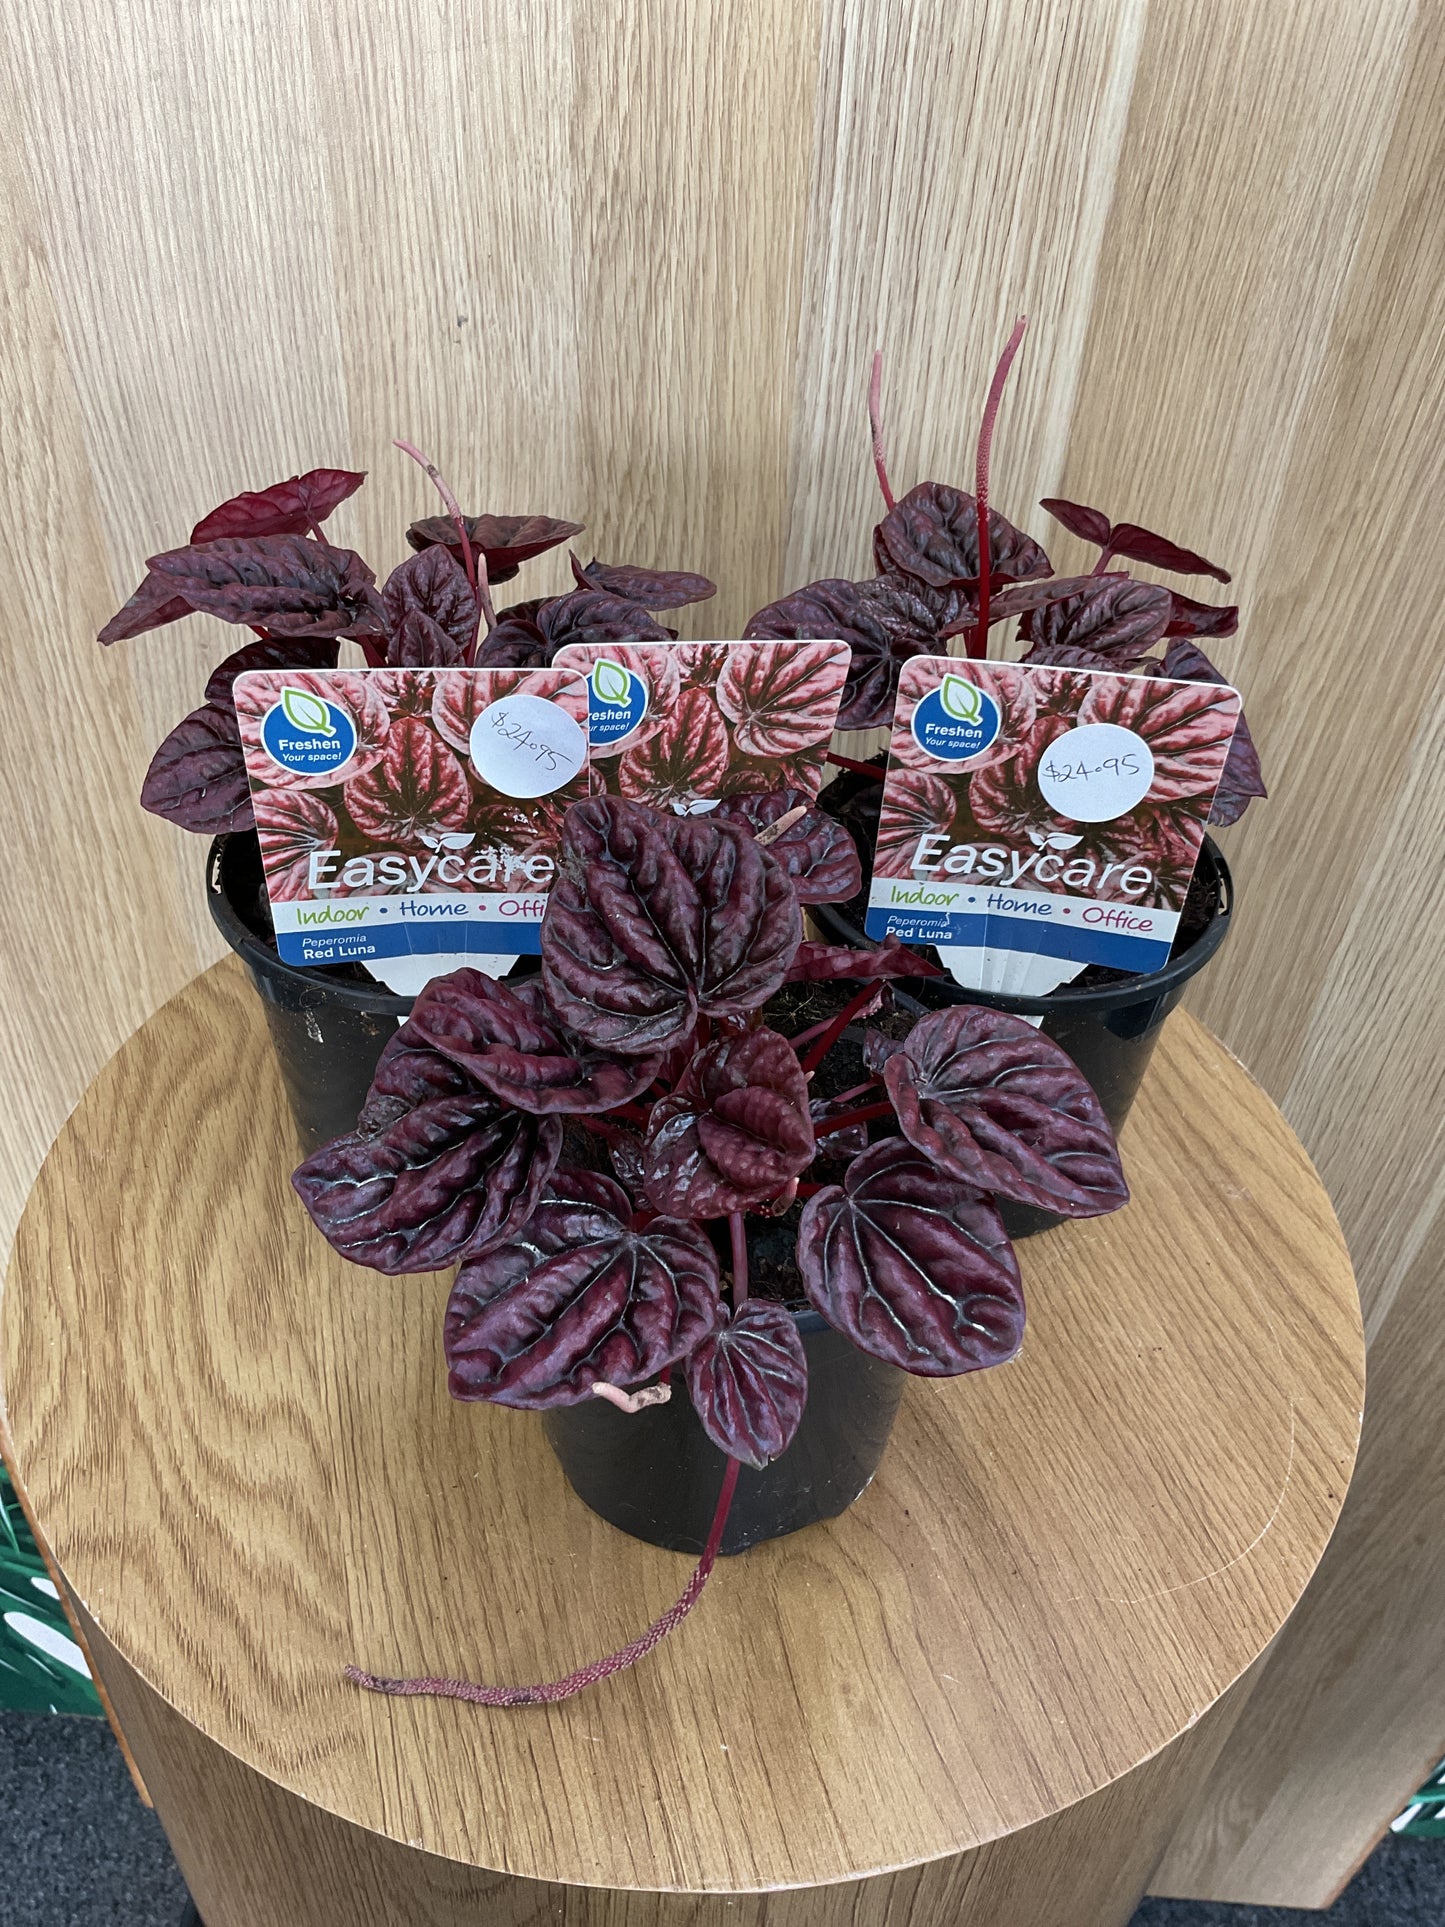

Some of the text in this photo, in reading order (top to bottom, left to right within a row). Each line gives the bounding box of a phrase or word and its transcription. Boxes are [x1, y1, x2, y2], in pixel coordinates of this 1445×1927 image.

[589, 709, 631, 721] reshen
[599, 722, 630, 733] space!
[925, 723, 983, 739] Freshen
[278, 738, 341, 751] Freshen
[491, 711, 574, 771] $24.95
[925, 737, 981, 749] Your space!
[282, 752, 342, 763] Your space!
[1043, 753, 1140, 783] $24.95
[308, 849, 555, 893] Easycare
[909, 833, 1153, 895] Easycare
[296, 899, 546, 925] Indoor Home Offi
[890, 885, 1153, 933] Indoor Home Office
[887, 915, 949, 928] Peperomia
[302, 933, 367, 948] Peperomia
[886, 926, 953, 940] Red Luna
[303, 945, 376, 960] Red Luna
